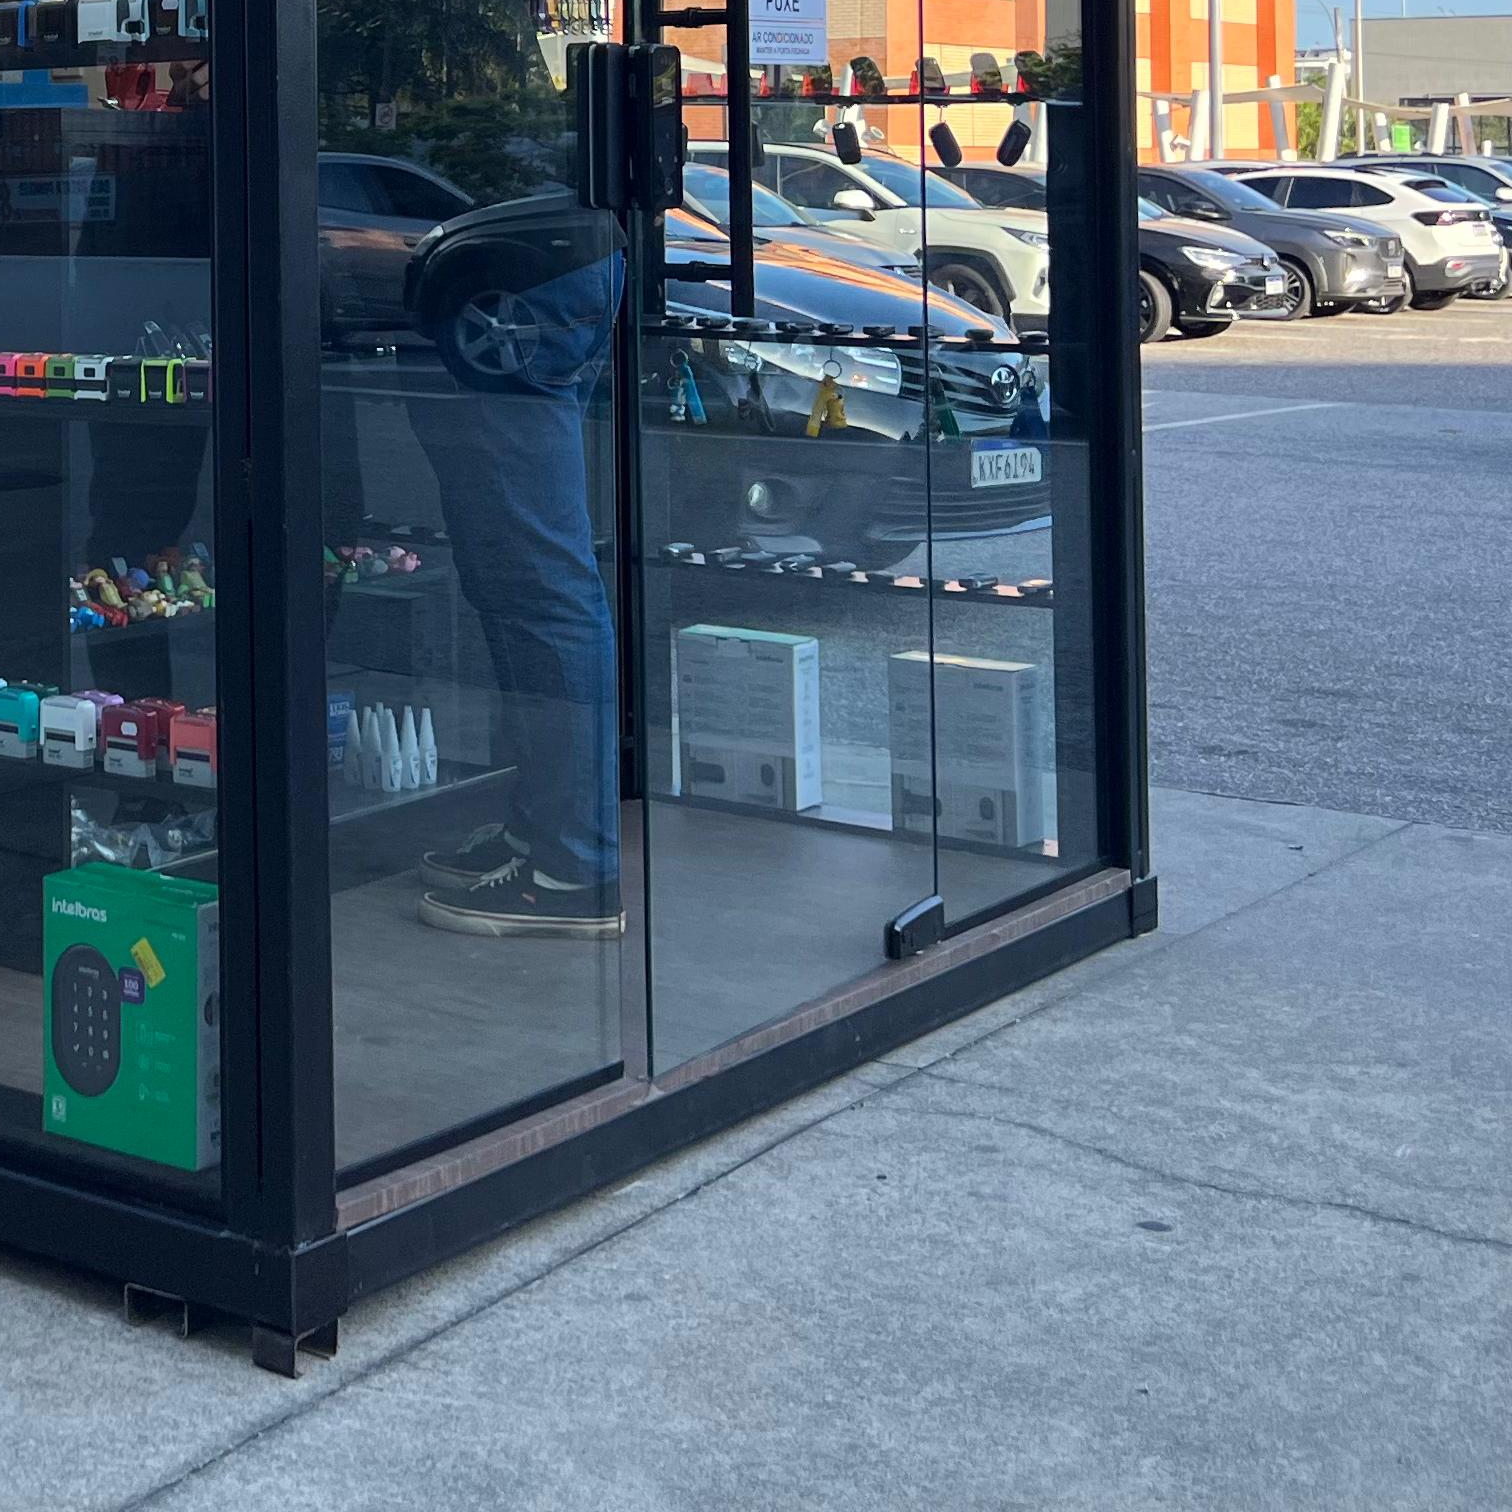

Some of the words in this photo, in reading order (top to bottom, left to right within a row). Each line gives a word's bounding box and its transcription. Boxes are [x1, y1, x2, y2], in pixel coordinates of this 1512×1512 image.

[752, 32, 762, 43] AR
[763, 32, 814, 45] CONDICIONADO
[52, 896, 107, 923] intelbras
